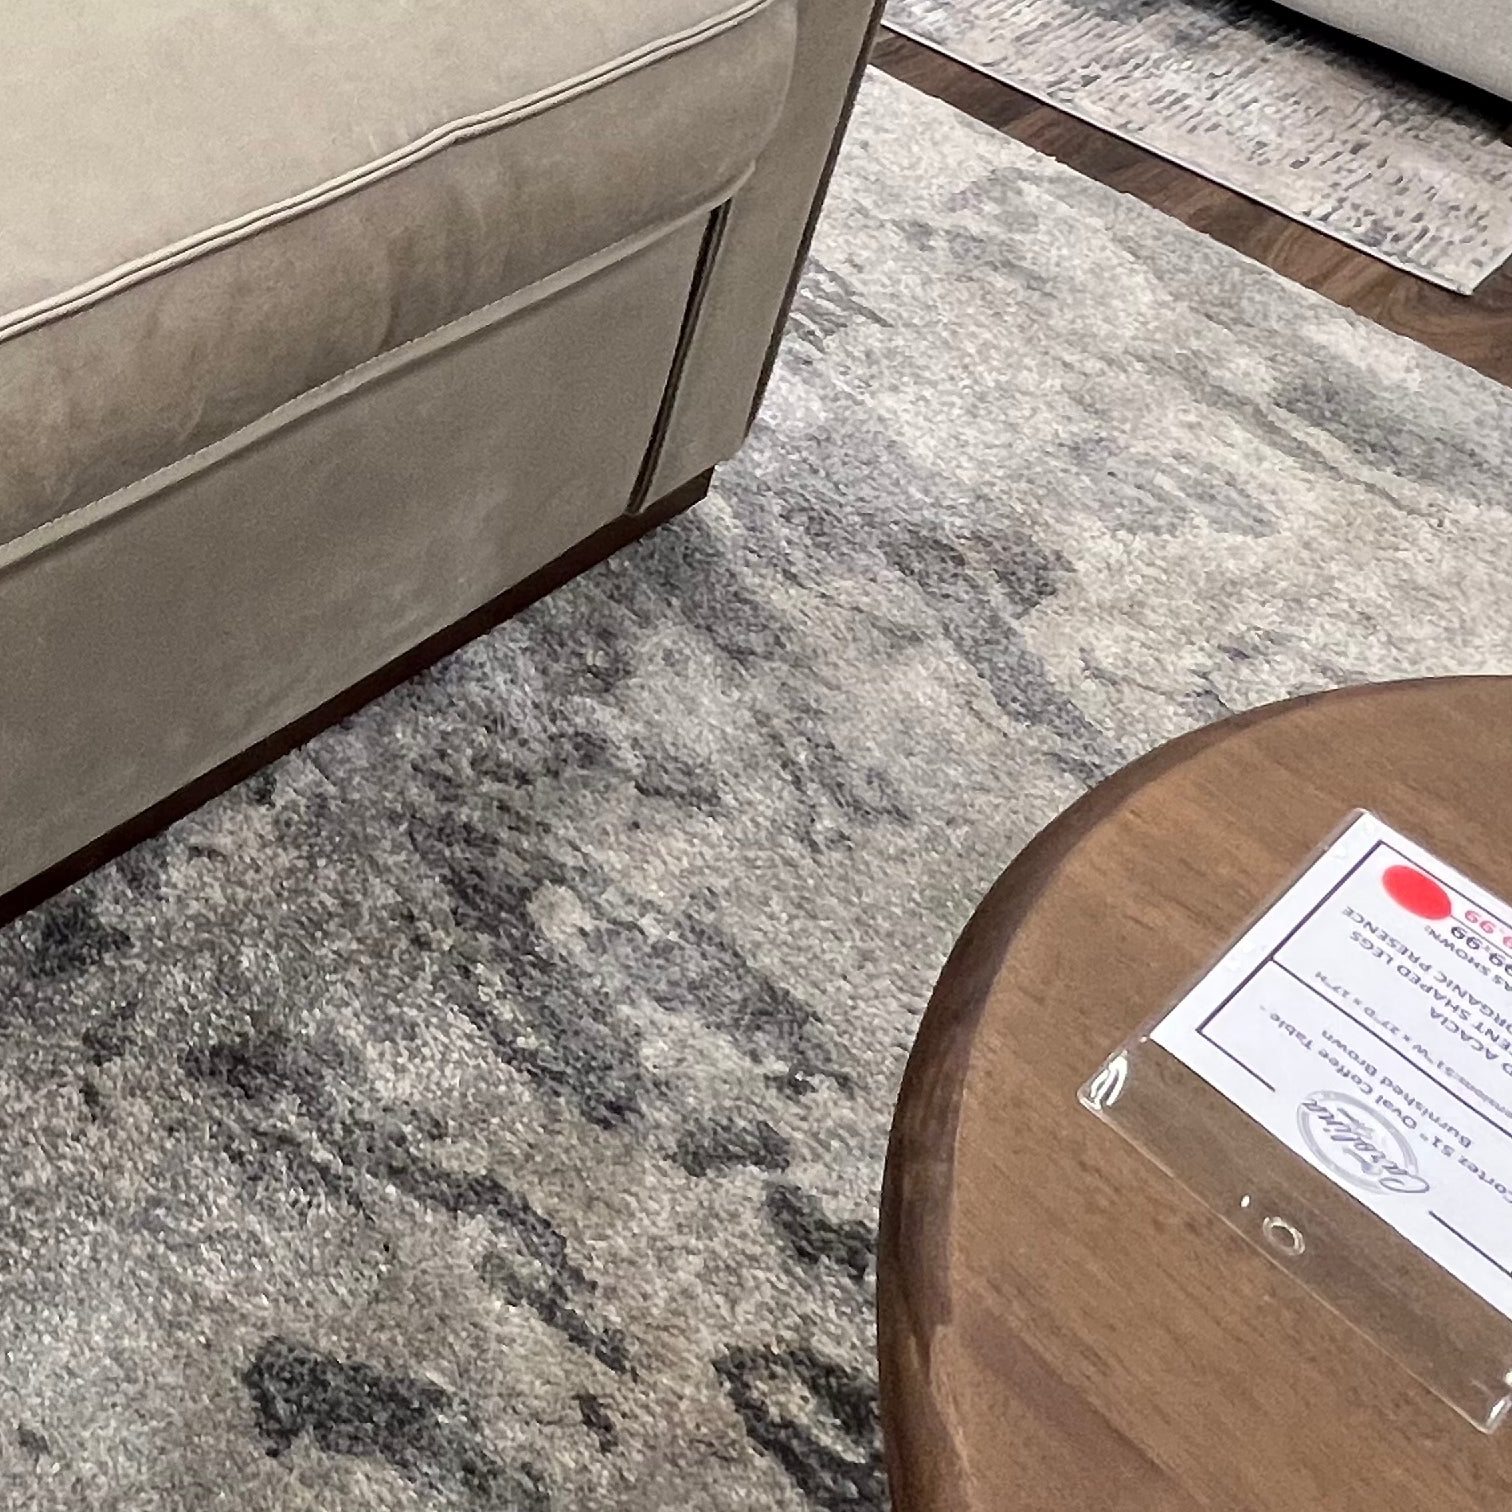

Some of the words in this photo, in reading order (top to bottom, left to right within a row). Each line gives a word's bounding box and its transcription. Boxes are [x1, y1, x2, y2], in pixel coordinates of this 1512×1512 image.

[1342, 906, 1432, 971] PRESENCE
[1350, 931, 1393, 964] LEGS
[1396, 964, 1471, 1020] SHAPED
[1269, 1013, 1312, 1049] Table
[1321, 1029, 1377, 1076] Brown
[1430, 1006, 1498, 1060] ACACIA
[1472, 1021, 1511, 1054] ENT
[1318, 1049, 1373, 1095] Coffee
[1374, 1094, 1417, 1129] Oval
[1379, 1075, 1471, 1148] Burnished
[1296, 1098, 1430, 1193] Carolina
